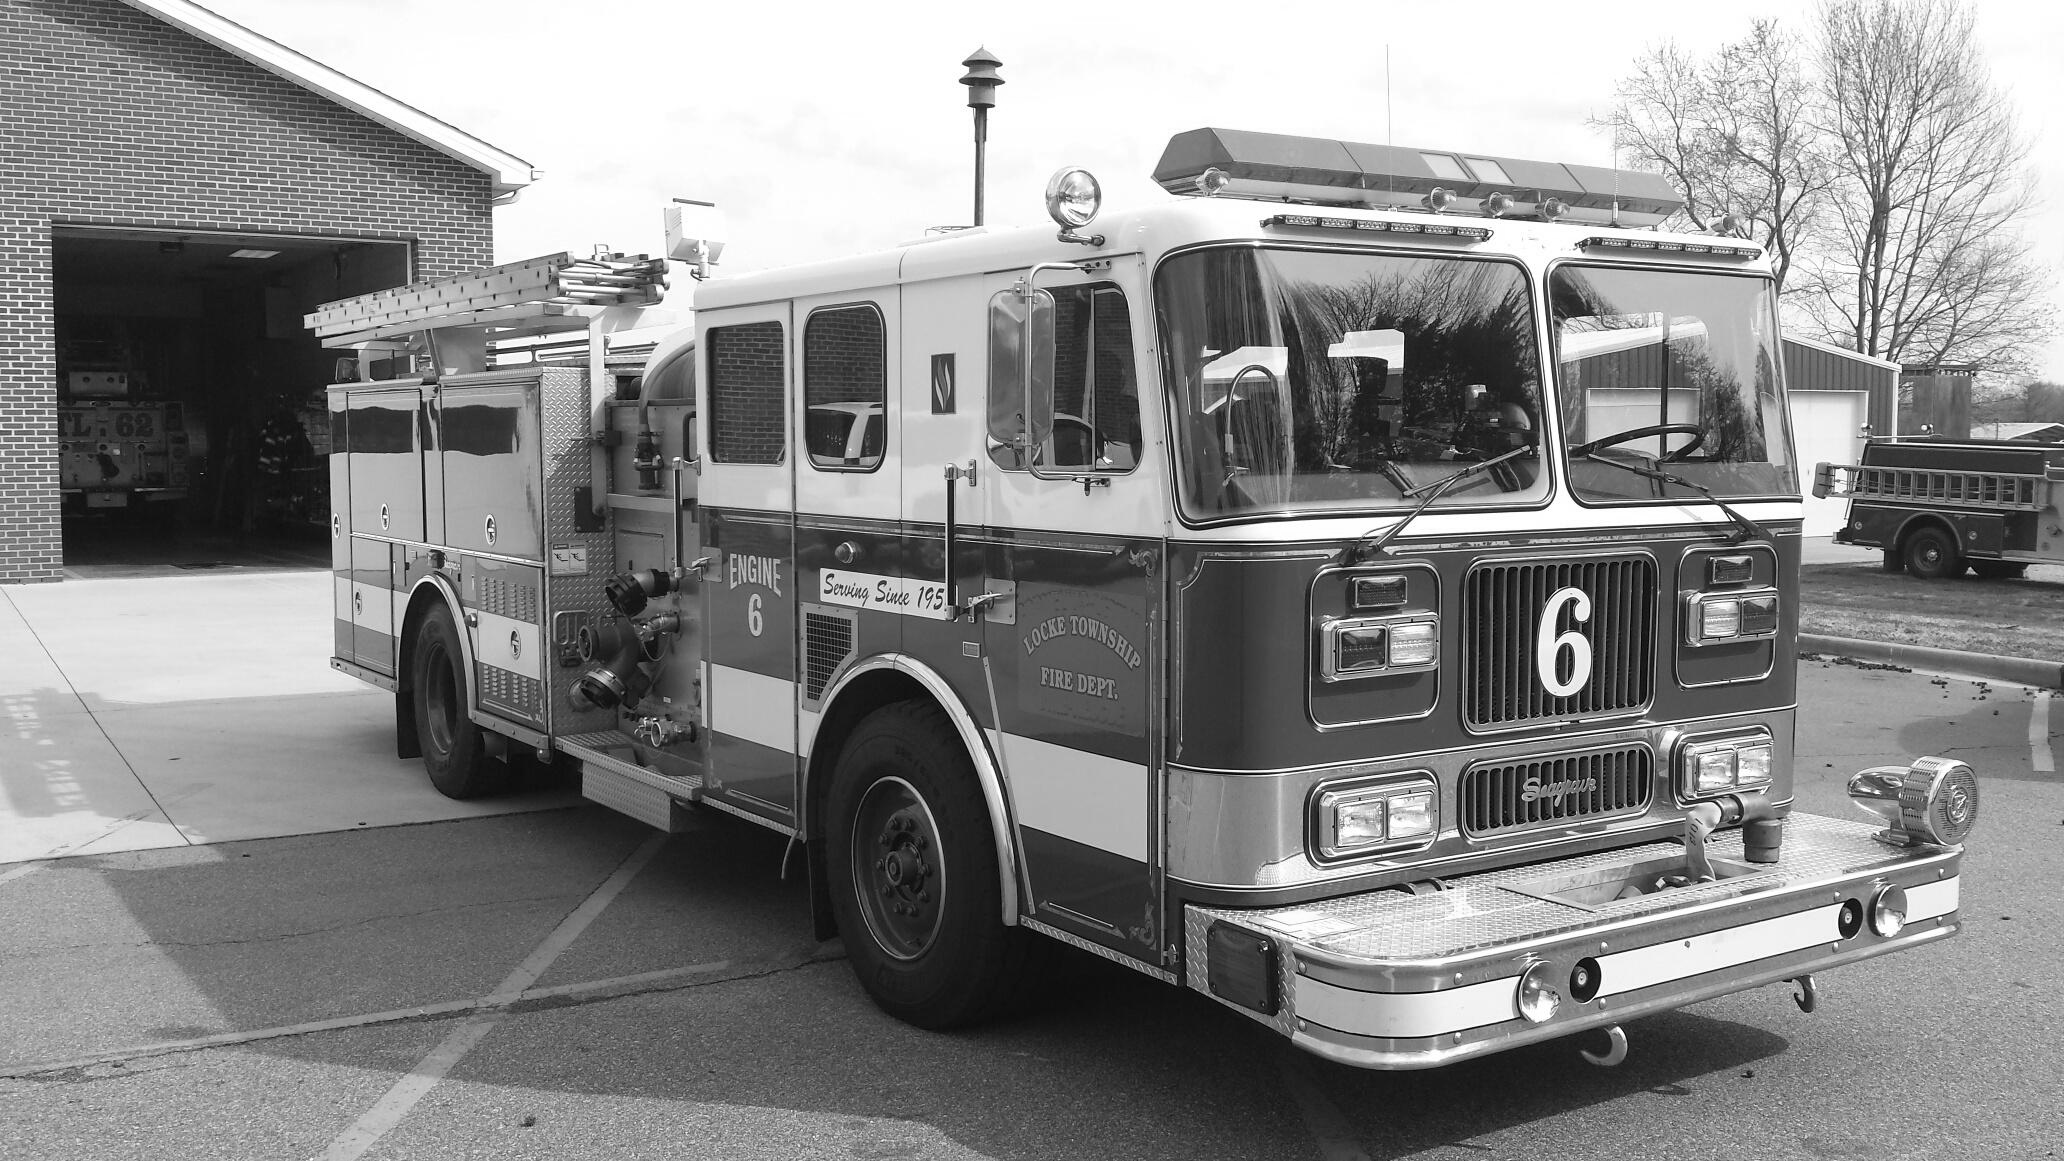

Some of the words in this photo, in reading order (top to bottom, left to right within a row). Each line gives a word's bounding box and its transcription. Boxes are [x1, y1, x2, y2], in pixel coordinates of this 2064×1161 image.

[115, 412, 154, 437] 62
[729, 553, 781, 598] ENGINE
[823, 572, 870, 607] Serving
[874, 580, 911, 606] Since
[917, 586, 946, 610] 195
[748, 593, 763, 637] 6
[1023, 616, 1066, 656] LOCKE
[1069, 615, 1141, 670] TOWNSHIP
[1537, 586, 1592, 697] 6
[1040, 666, 1073, 690] FIRE
[1077, 673, 1118, 700] DEPT.
